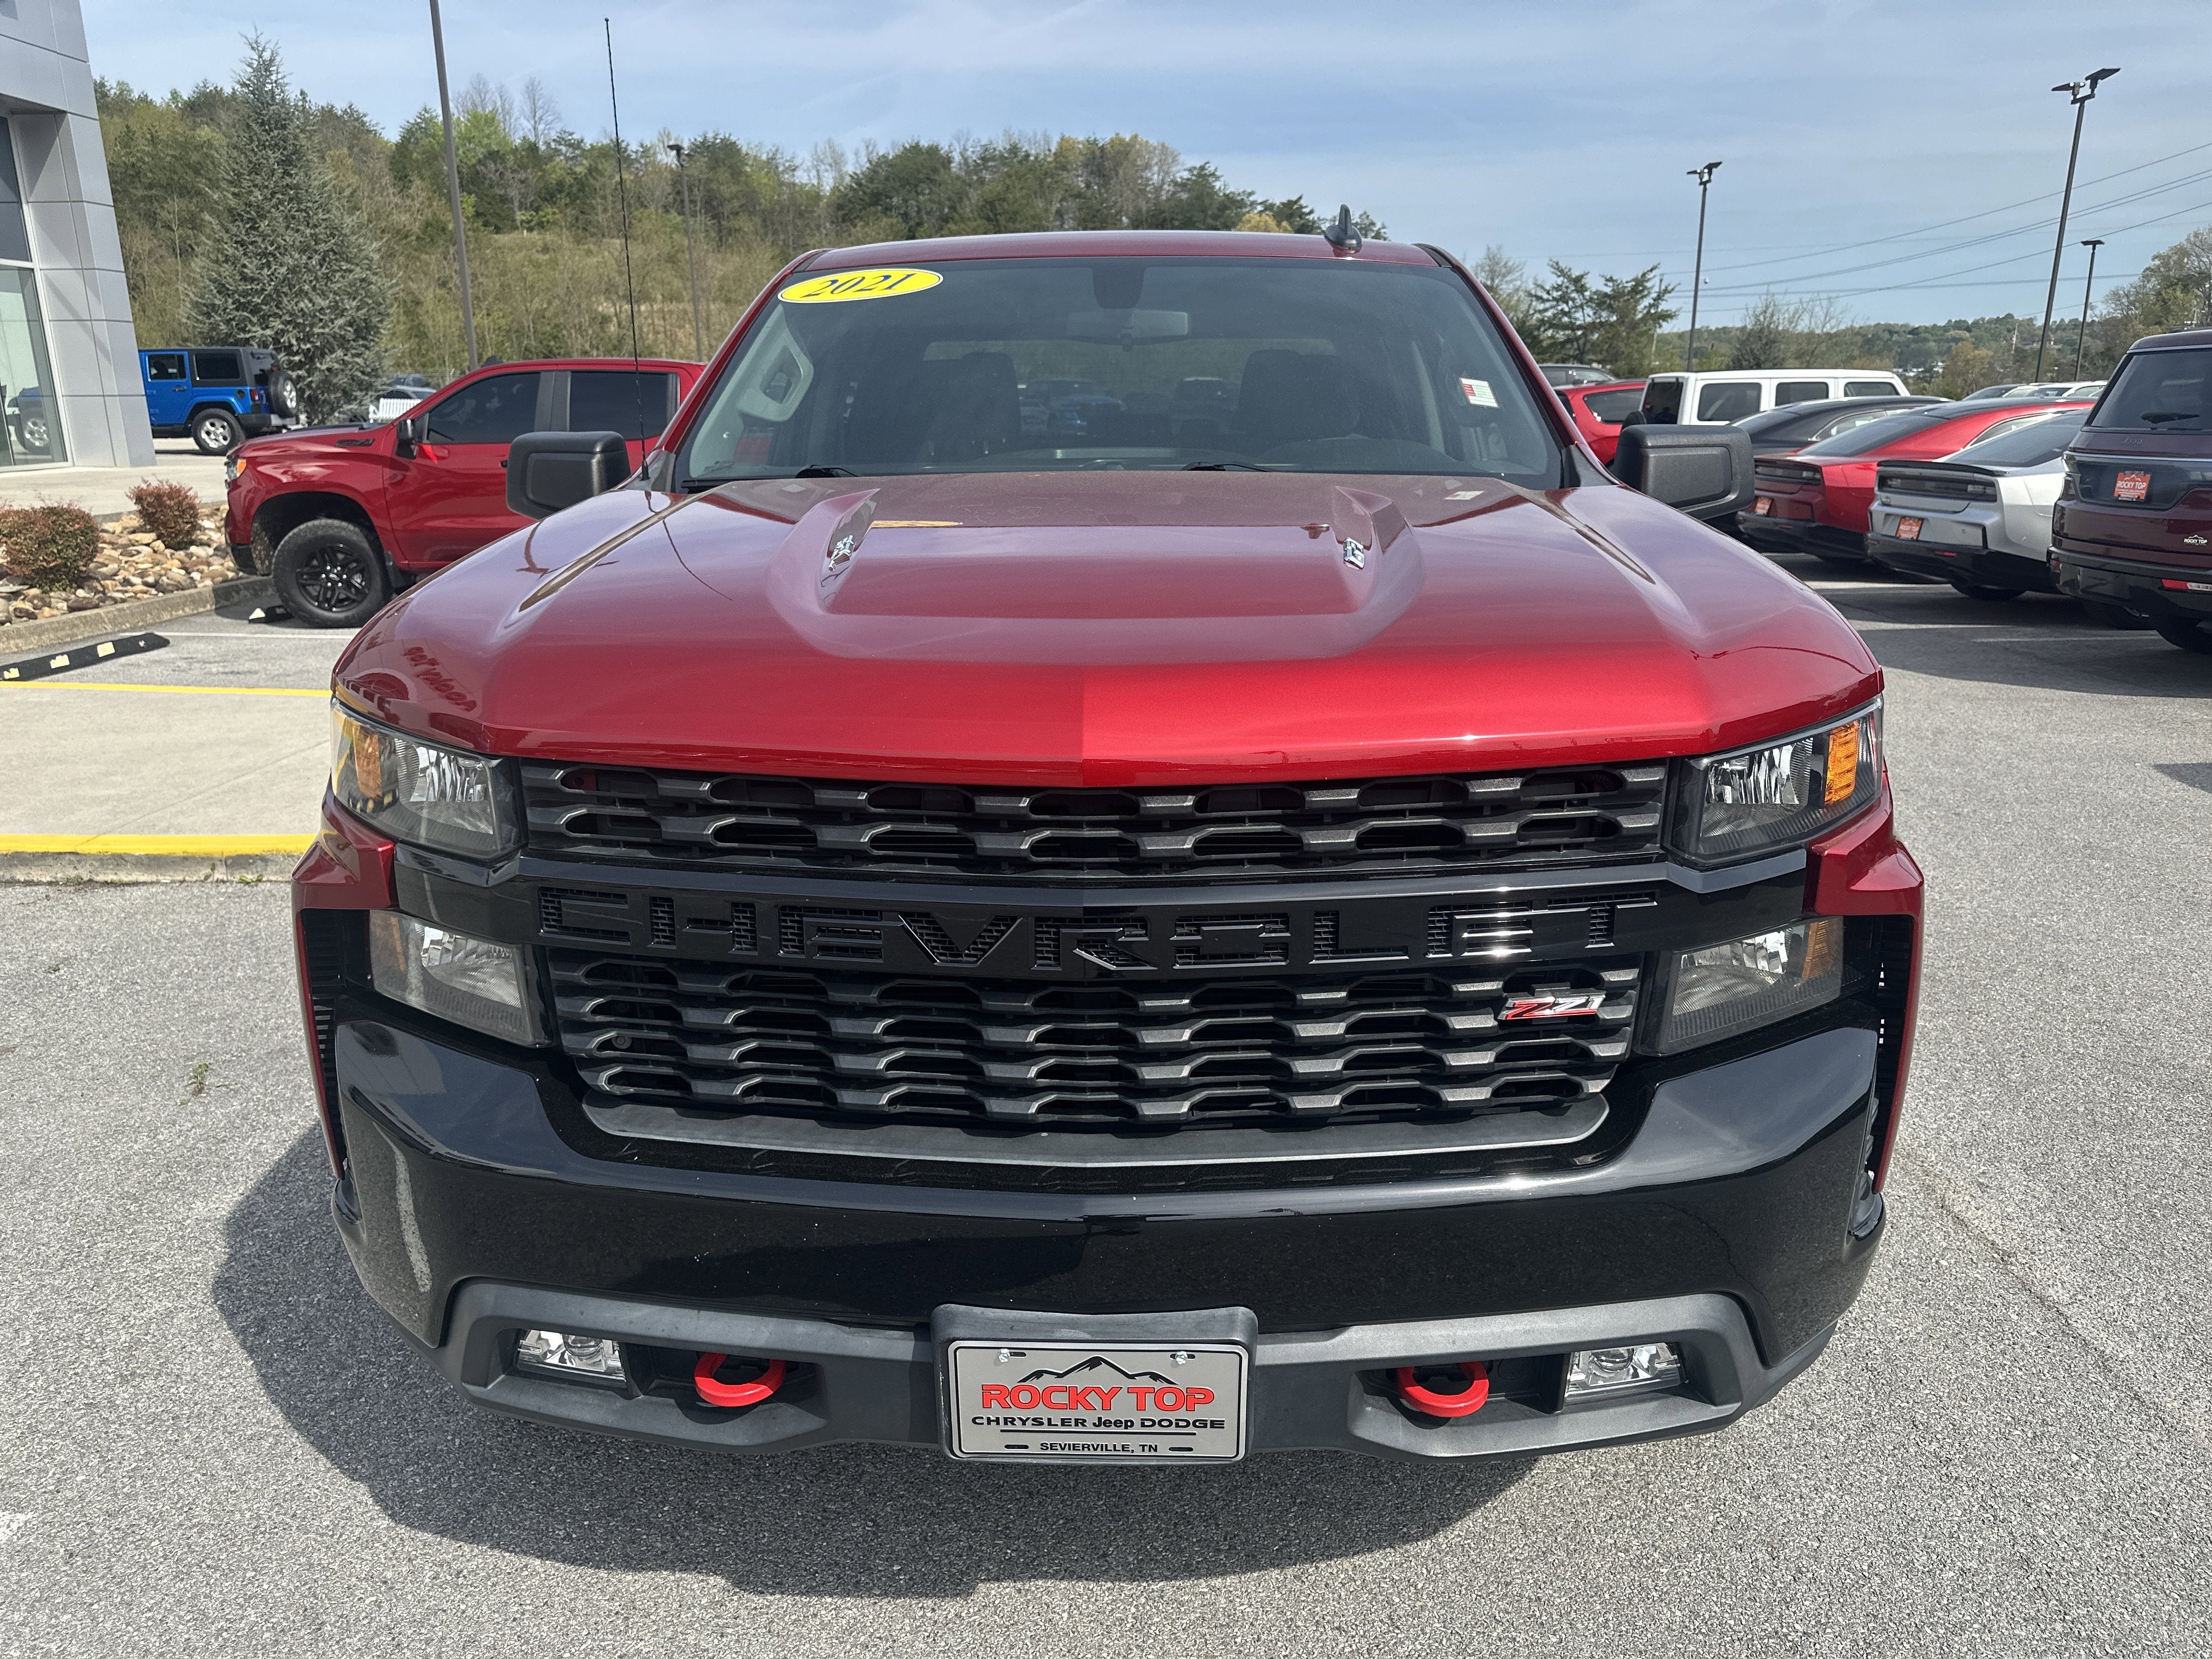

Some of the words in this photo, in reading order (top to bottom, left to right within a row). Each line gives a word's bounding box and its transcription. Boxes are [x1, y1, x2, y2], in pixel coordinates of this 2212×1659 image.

[800, 273, 917, 298] 2021
[538, 885, 1658, 971] CHEVROLET
[1497, 994, 1606, 1020] Z71
[981, 1384, 1122, 1410] ROCKY
[1127, 1386, 1215, 1412] TOP
[971, 1415, 1088, 1427] CHRYSLER
[1092, 1416, 1135, 1429] Jeep
[1140, 1418, 1226, 1429] DODGE
[1040, 1442, 1135, 1454] SEVIERVILLE,
[1138, 1443, 1158, 1453] TN
